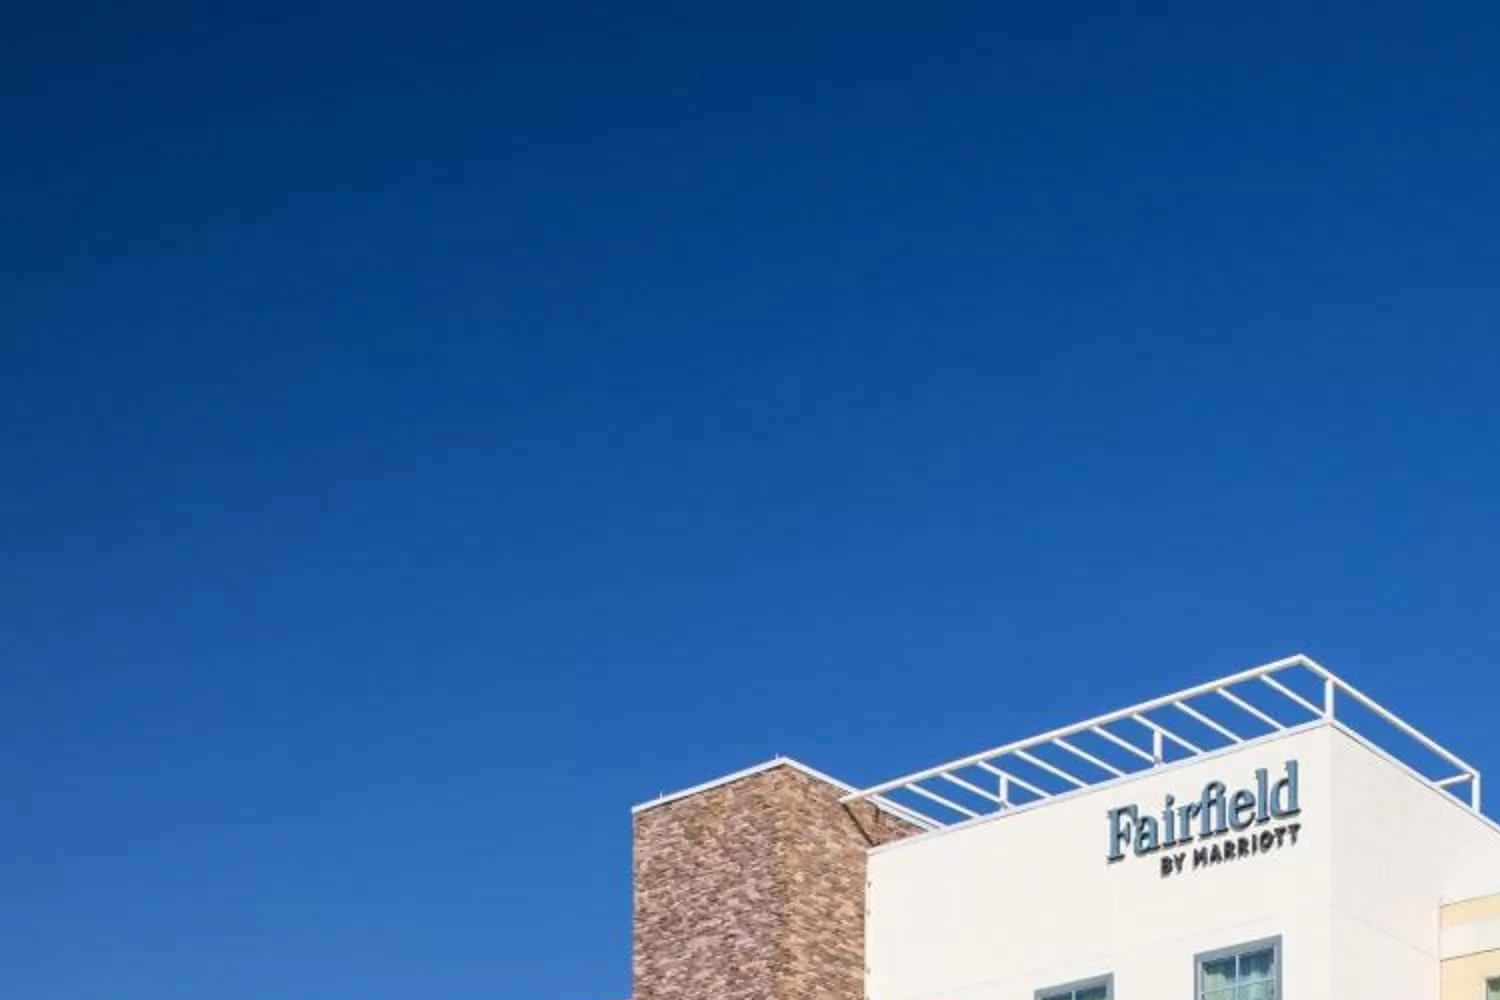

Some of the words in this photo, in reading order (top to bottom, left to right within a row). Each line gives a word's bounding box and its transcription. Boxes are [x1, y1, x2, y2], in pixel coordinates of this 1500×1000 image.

[1107, 760, 1301, 864] Fairfield
[1160, 852, 1187, 877] BY
[1193, 823, 1301, 868] MARRIOTT
